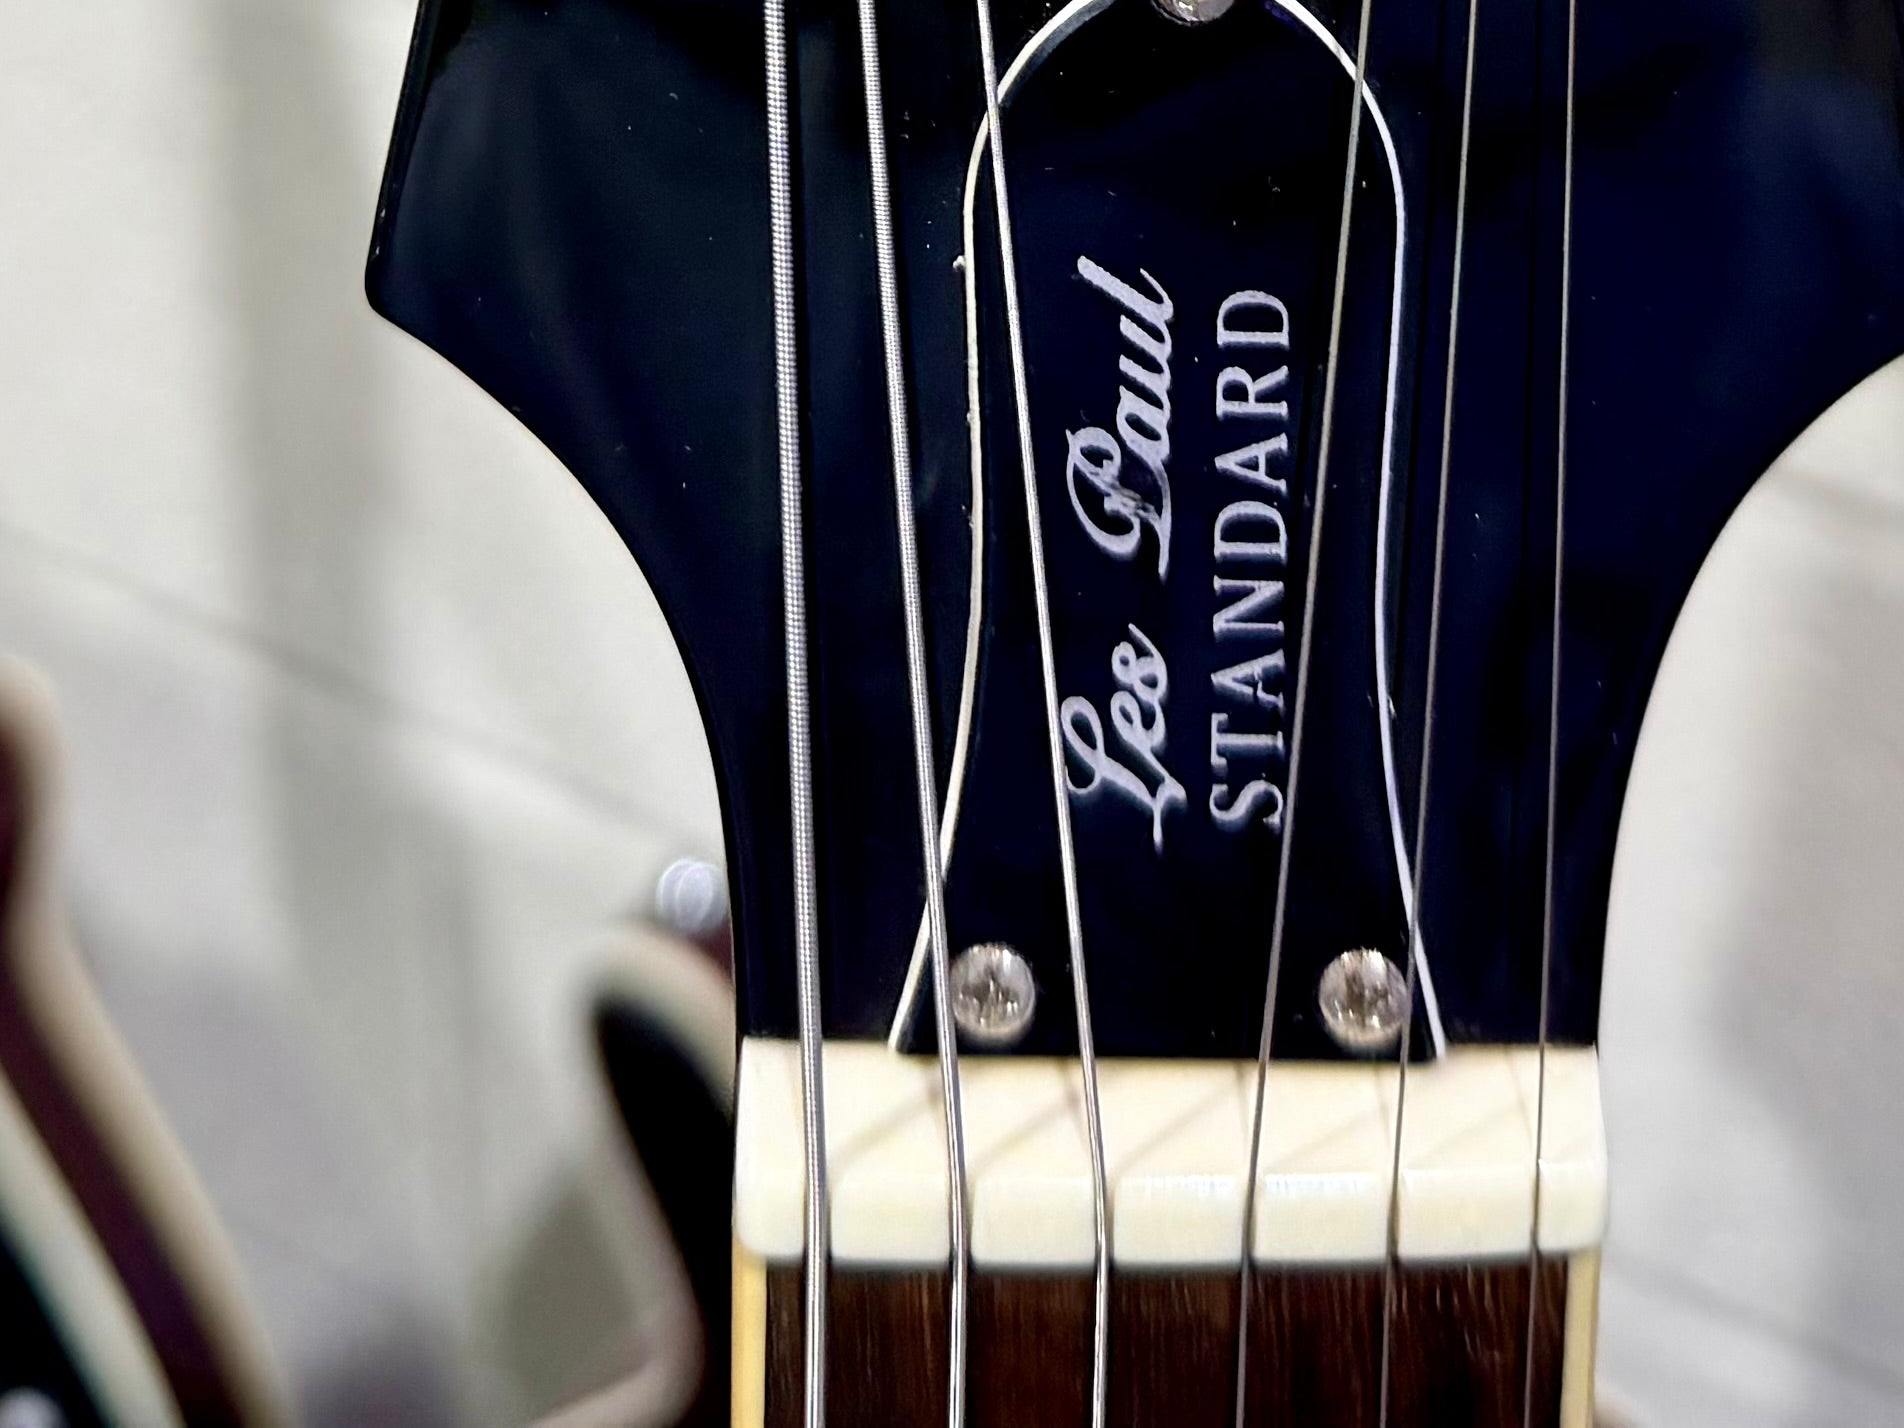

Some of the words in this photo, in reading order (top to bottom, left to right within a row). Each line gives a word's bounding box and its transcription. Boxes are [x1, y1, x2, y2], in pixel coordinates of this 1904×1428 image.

[1065, 254, 1175, 578] Paul
[1209, 289, 1290, 828] STANDARD
[1060, 622, 1188, 852] Les
